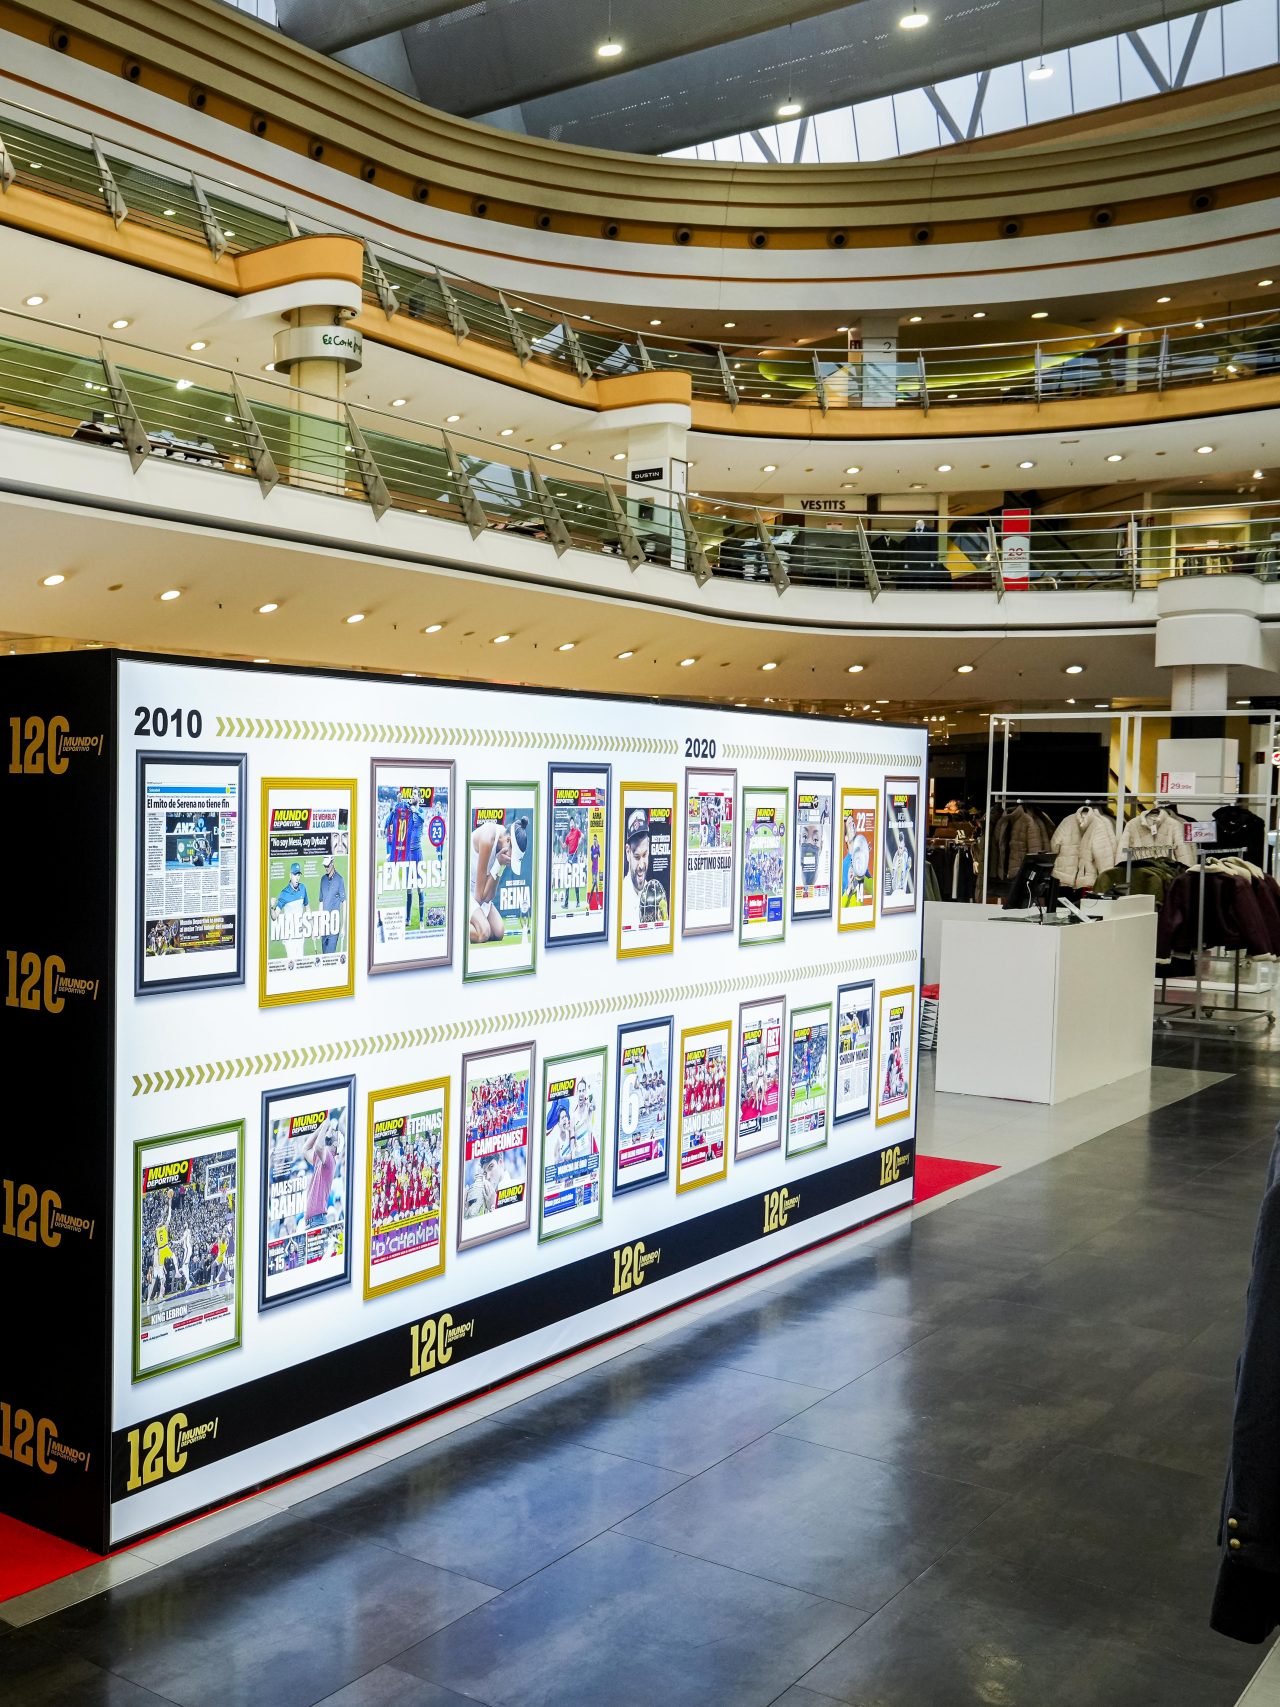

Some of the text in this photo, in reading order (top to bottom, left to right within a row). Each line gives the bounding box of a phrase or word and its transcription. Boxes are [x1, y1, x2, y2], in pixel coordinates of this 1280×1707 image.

[322, 334, 353, 348] El Corte
[800, 499, 846, 510] VESTITS
[133, 706, 203, 738] 2010
[62, 736, 99, 748] MUNDO
[685, 737, 717, 759] 2020
[401, 787, 432, 799] MUDO
[556, 790, 579, 799] MUNDO
[147, 798, 230, 809] El mito de Serena no tiene fin
[274, 809, 309, 821] MUNDO
[477, 809, 504, 819] MUNDO
[650, 808, 671, 818] MUNDO
[173, 822, 196, 834] ANZ
[856, 812, 866, 832] 22
[432, 827, 442, 839] 2-3
[280, 839, 288, 848] soy
[650, 843, 671, 856] GASOL
[687, 857, 694, 871] EL
[717, 855, 732, 870] SELLO
[553, 863, 587, 890] TIGRE
[500, 886, 531, 911] REINA
[271, 909, 340, 941] MAESTRO
[58, 976, 94, 991] MUNDO
[58, 986, 86, 995] DEPORTIVO
[767, 1027, 780, 1047] REY
[890, 1031, 902, 1051] REY
[551, 1079, 575, 1093] MUNDO
[621, 1073, 640, 1135] 6
[292, 1111, 325, 1128] MUNDO
[375, 1117, 404, 1134] MUNDO
[406, 1111, 442, 1135] ETERNAS
[291, 1122, 318, 1135] DEPORTIVO
[471, 1128, 524, 1159] ¡CAMPEONES!
[147, 1160, 189, 1181] MUNDO
[146, 1175, 179, 1188] DEPORTIVO
[271, 1176, 307, 1196] MAESTRO
[498, 1184, 523, 1200] MUNDO
[54, 1222, 82, 1233] DEPORTIVO
[55, 1212, 90, 1230] MUNDO
[151, 1311, 166, 1325] KING
[165, 1304, 188, 1321] LEBRON
[448, 1322, 471, 1338] MUNDO
[181, 1421, 214, 1441] MUNDO
[50, 1449, 78, 1464] DEPORTIVO
[51, 1440, 86, 1461] MUNDO
